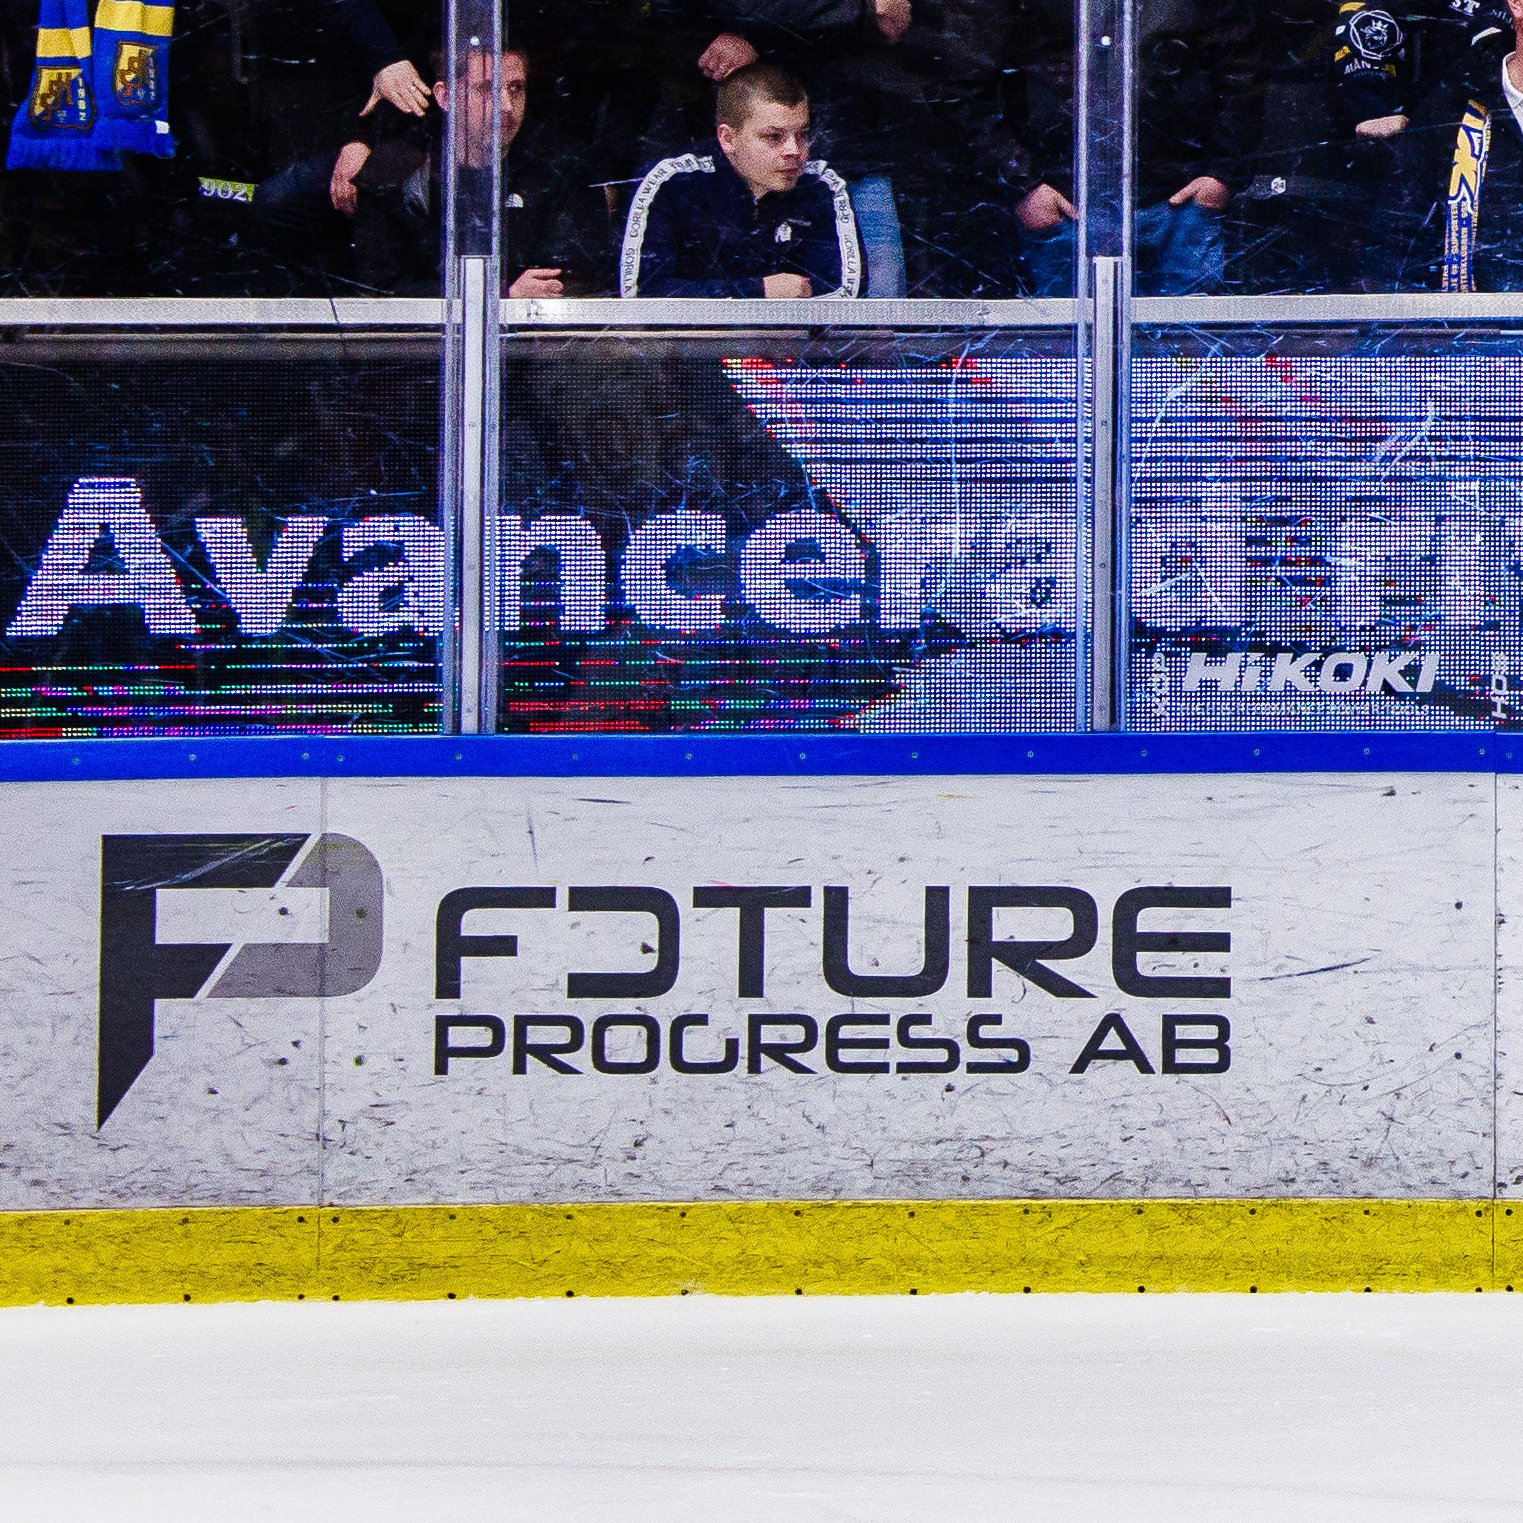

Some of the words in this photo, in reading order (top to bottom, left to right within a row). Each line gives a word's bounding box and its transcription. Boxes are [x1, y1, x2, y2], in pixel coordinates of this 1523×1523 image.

[1182, 652, 1445, 693] HiKOKI
[434, 1014, 1030, 1076] PROGRESS
[1069, 1014, 1233, 1076] AB
